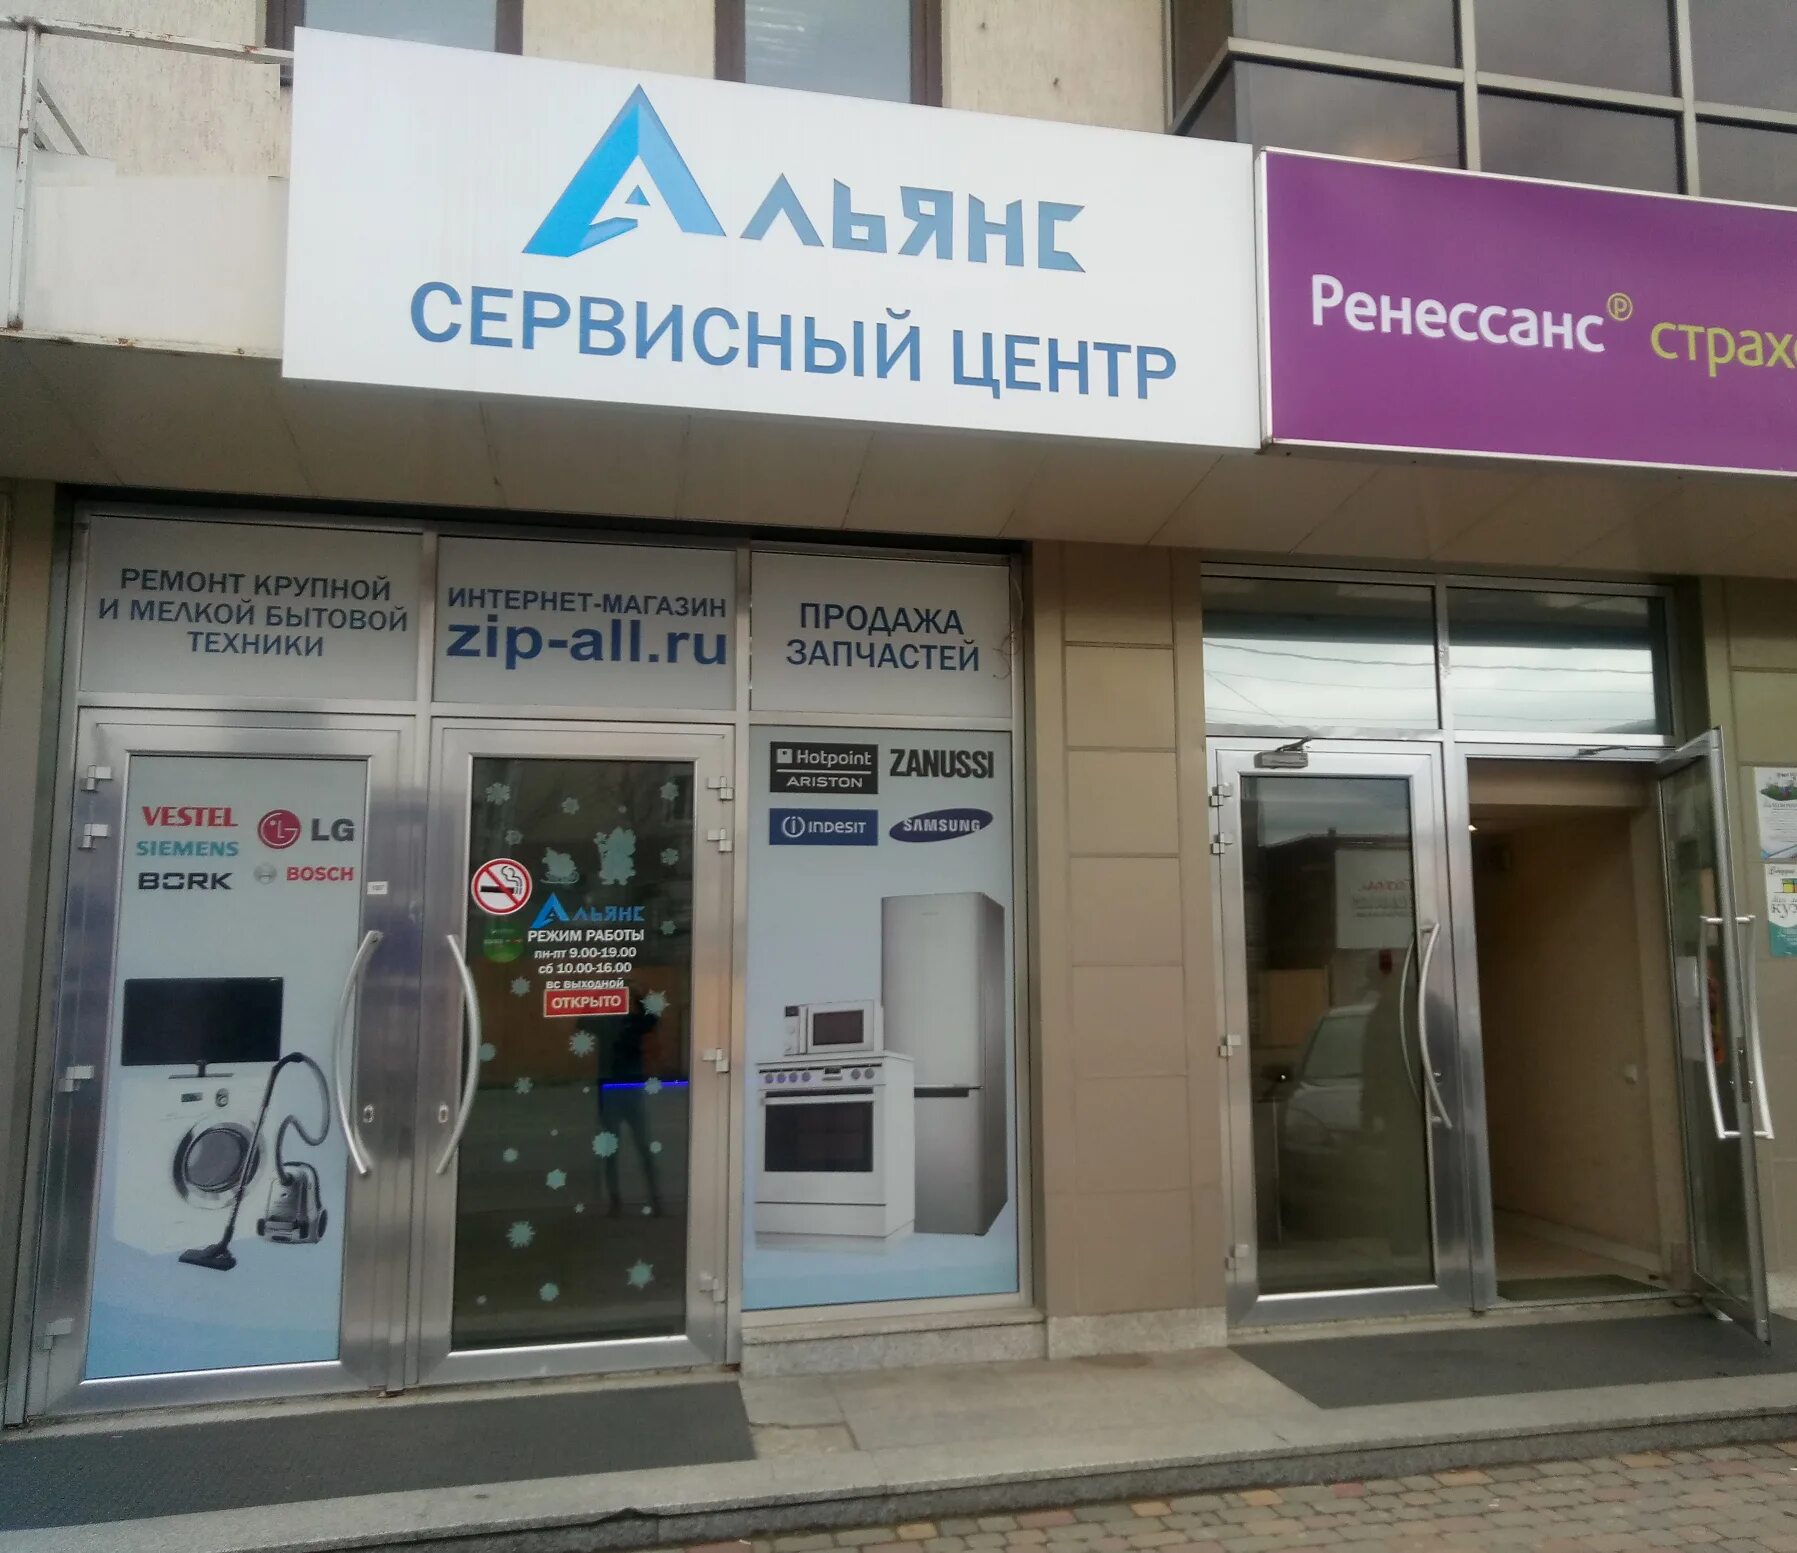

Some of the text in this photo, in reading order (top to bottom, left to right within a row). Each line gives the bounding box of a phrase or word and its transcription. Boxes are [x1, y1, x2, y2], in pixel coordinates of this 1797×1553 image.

[1311, 273, 1605, 352] Ренессанс
[1650, 321, 1797, 377] страх
[410, 281, 1177, 400] СЕРВИСНЫЙ ЦЕНТР
[120, 568, 391, 601] РЕМОНТ КРУПНОЙ
[447, 587, 727, 618] ИНТЕРНЕТ-МАГАЗИН
[99, 598, 408, 632] И МЕЛКОЙ БЫТОВОЙ
[800, 602, 965, 636] ПРОДАЖА
[187, 631, 324, 657] ТЕХНИКИ
[446, 614, 727, 670] zip-all.ru
[786, 638, 980, 672] ЗАПЧАСТЕЙ
[797, 749, 872, 768] Hotpoint
[889, 749, 995, 779] ZANUSSI
[786, 776, 863, 788] ARISTON
[142, 806, 239, 827] VESTEL
[903, 817, 980, 832] SAMSUNG
[311, 818, 355, 842] LG
[136, 841, 239, 857] SIEMENS
[138, 872, 233, 890] BORK
[286, 866, 354, 881] BOSCH
[527, 930, 582, 942] РЕЖИМ
[586, 929, 645, 942] РАБОТЫ
[569, 947, 637, 959] 9.00-19.00
[538, 962, 632, 974] сб 10.00-16.00
[551, 995, 622, 1009] ОТКРЫТО
